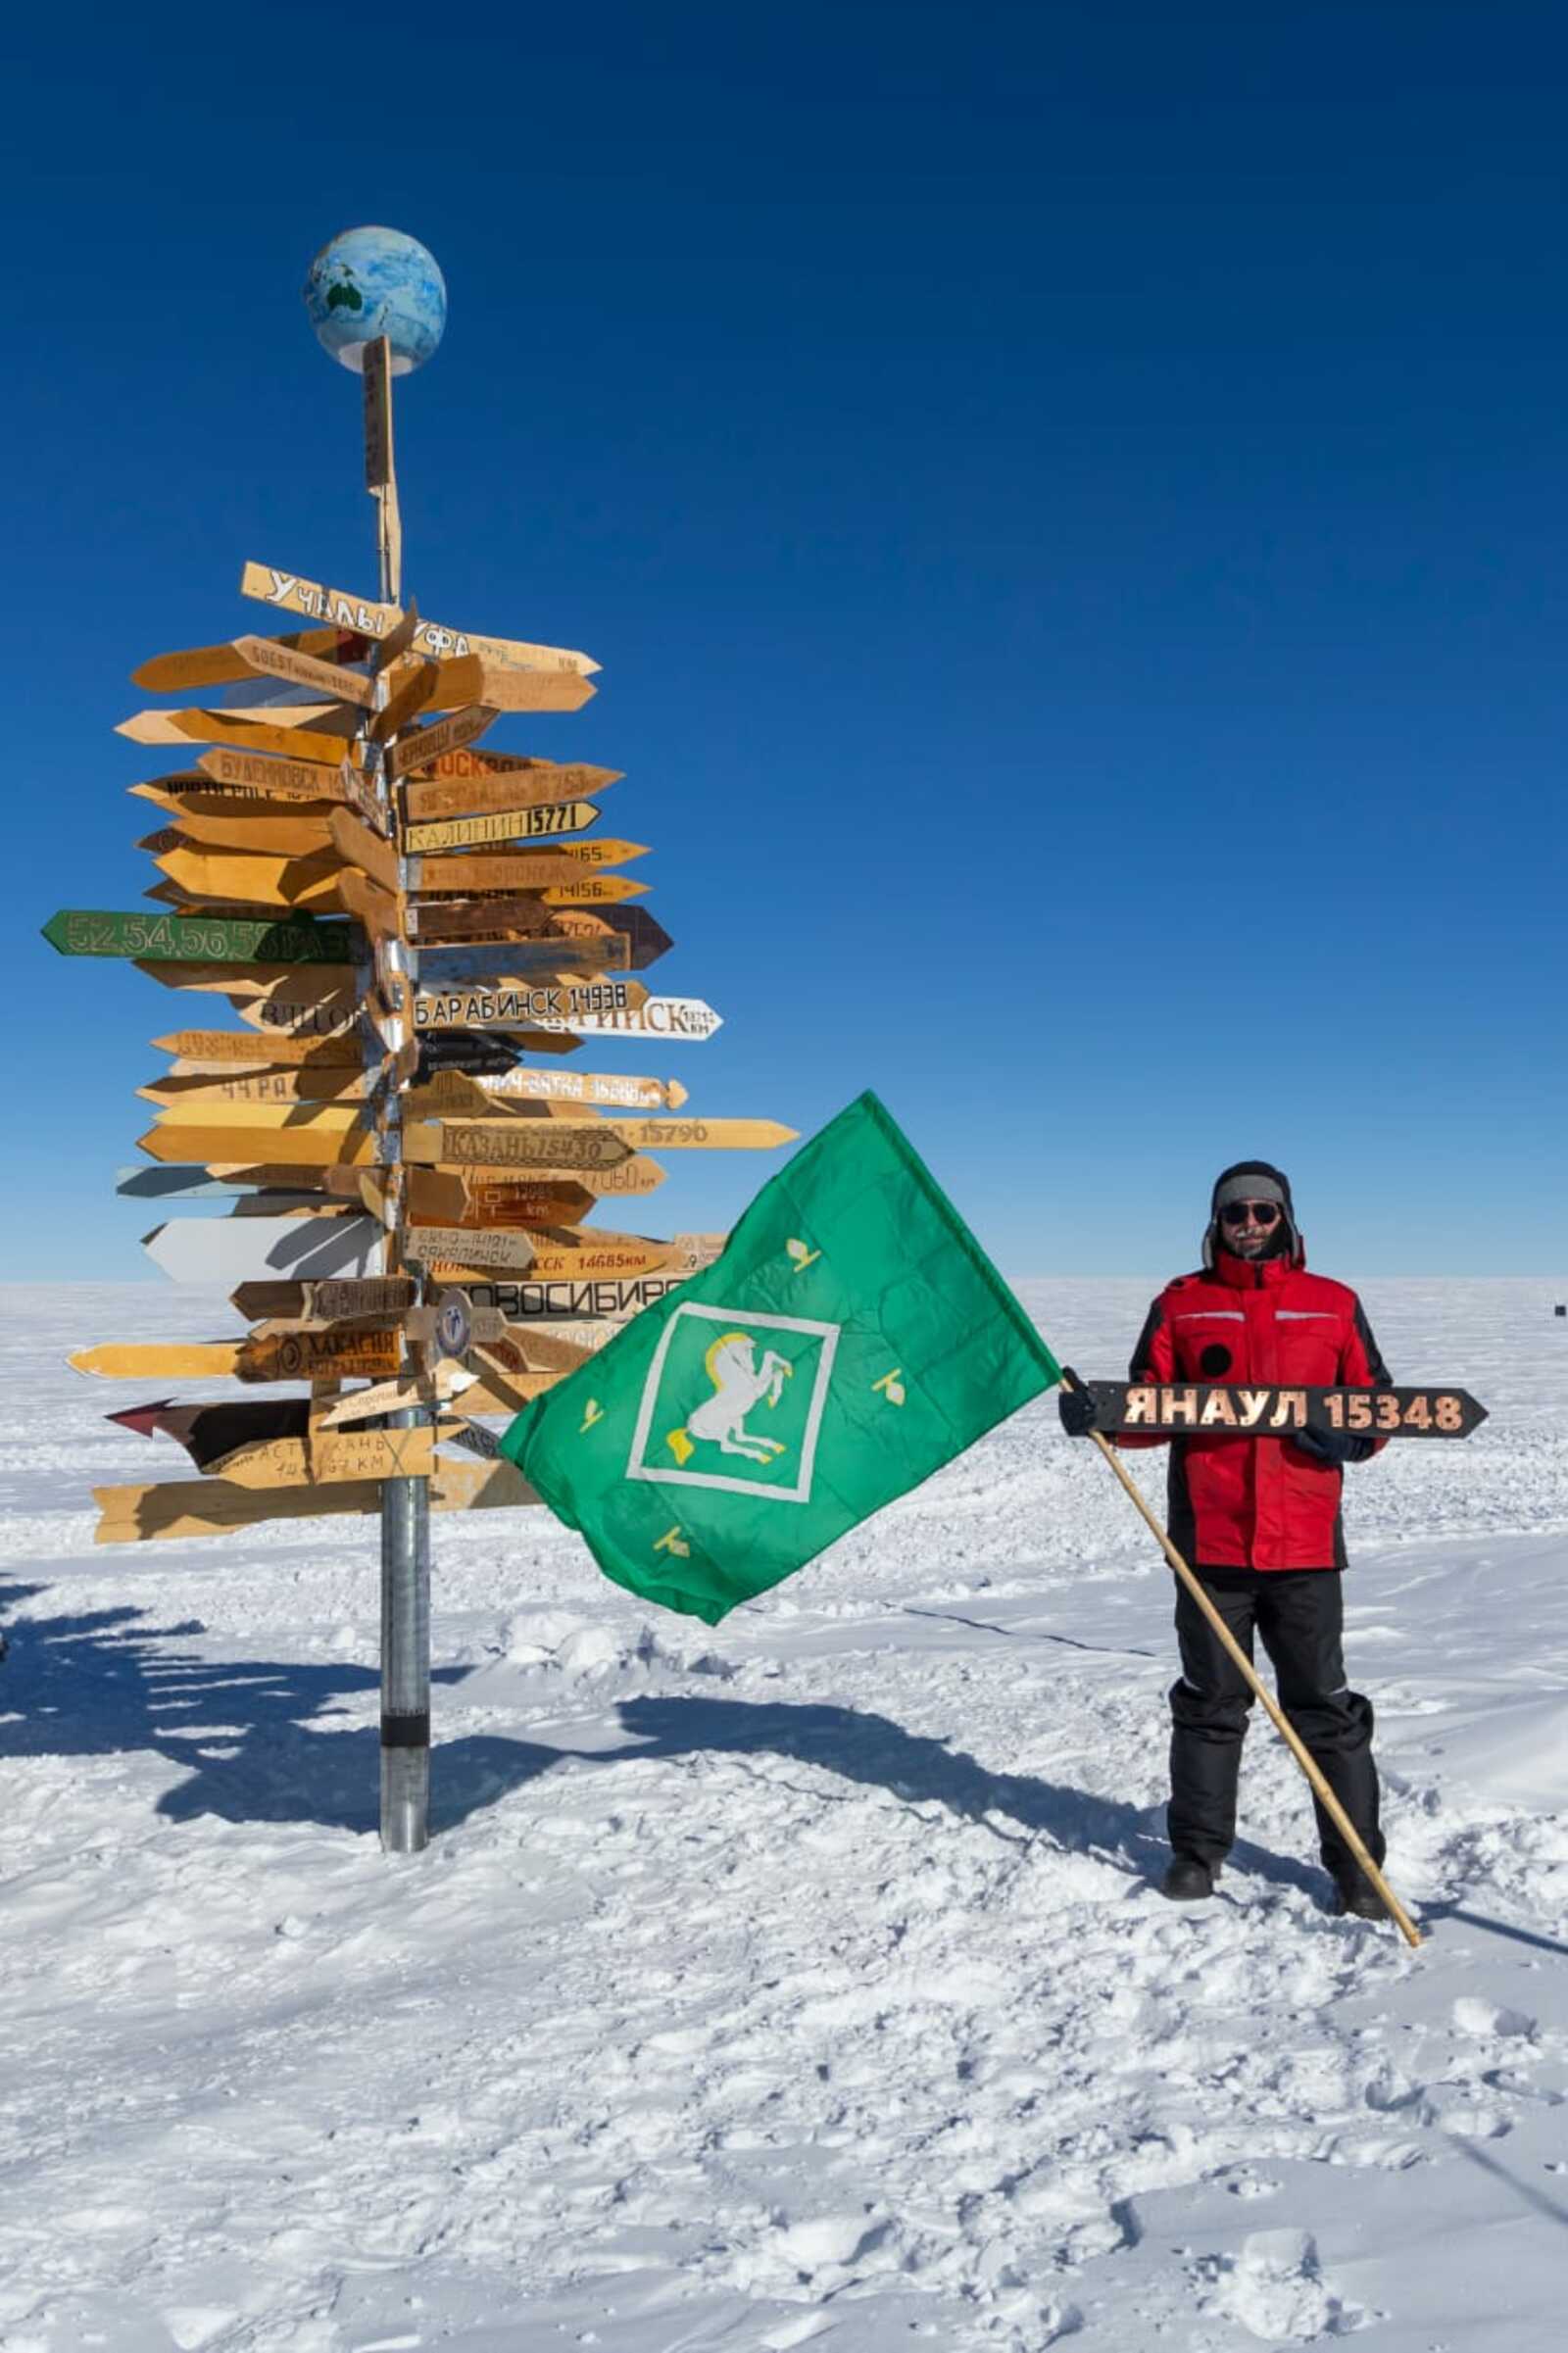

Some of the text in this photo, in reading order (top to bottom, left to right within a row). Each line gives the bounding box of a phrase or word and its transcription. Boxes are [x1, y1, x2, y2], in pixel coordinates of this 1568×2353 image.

[409, 805, 576, 849] КАЛИНИН 15771
[416, 984, 627, 1024] БАРАБИНСК 14938
[451, 1129, 535, 1155] КАЗАНЬ
[1123, 1388, 1463, 1431] ЯНАУЛ 15348
